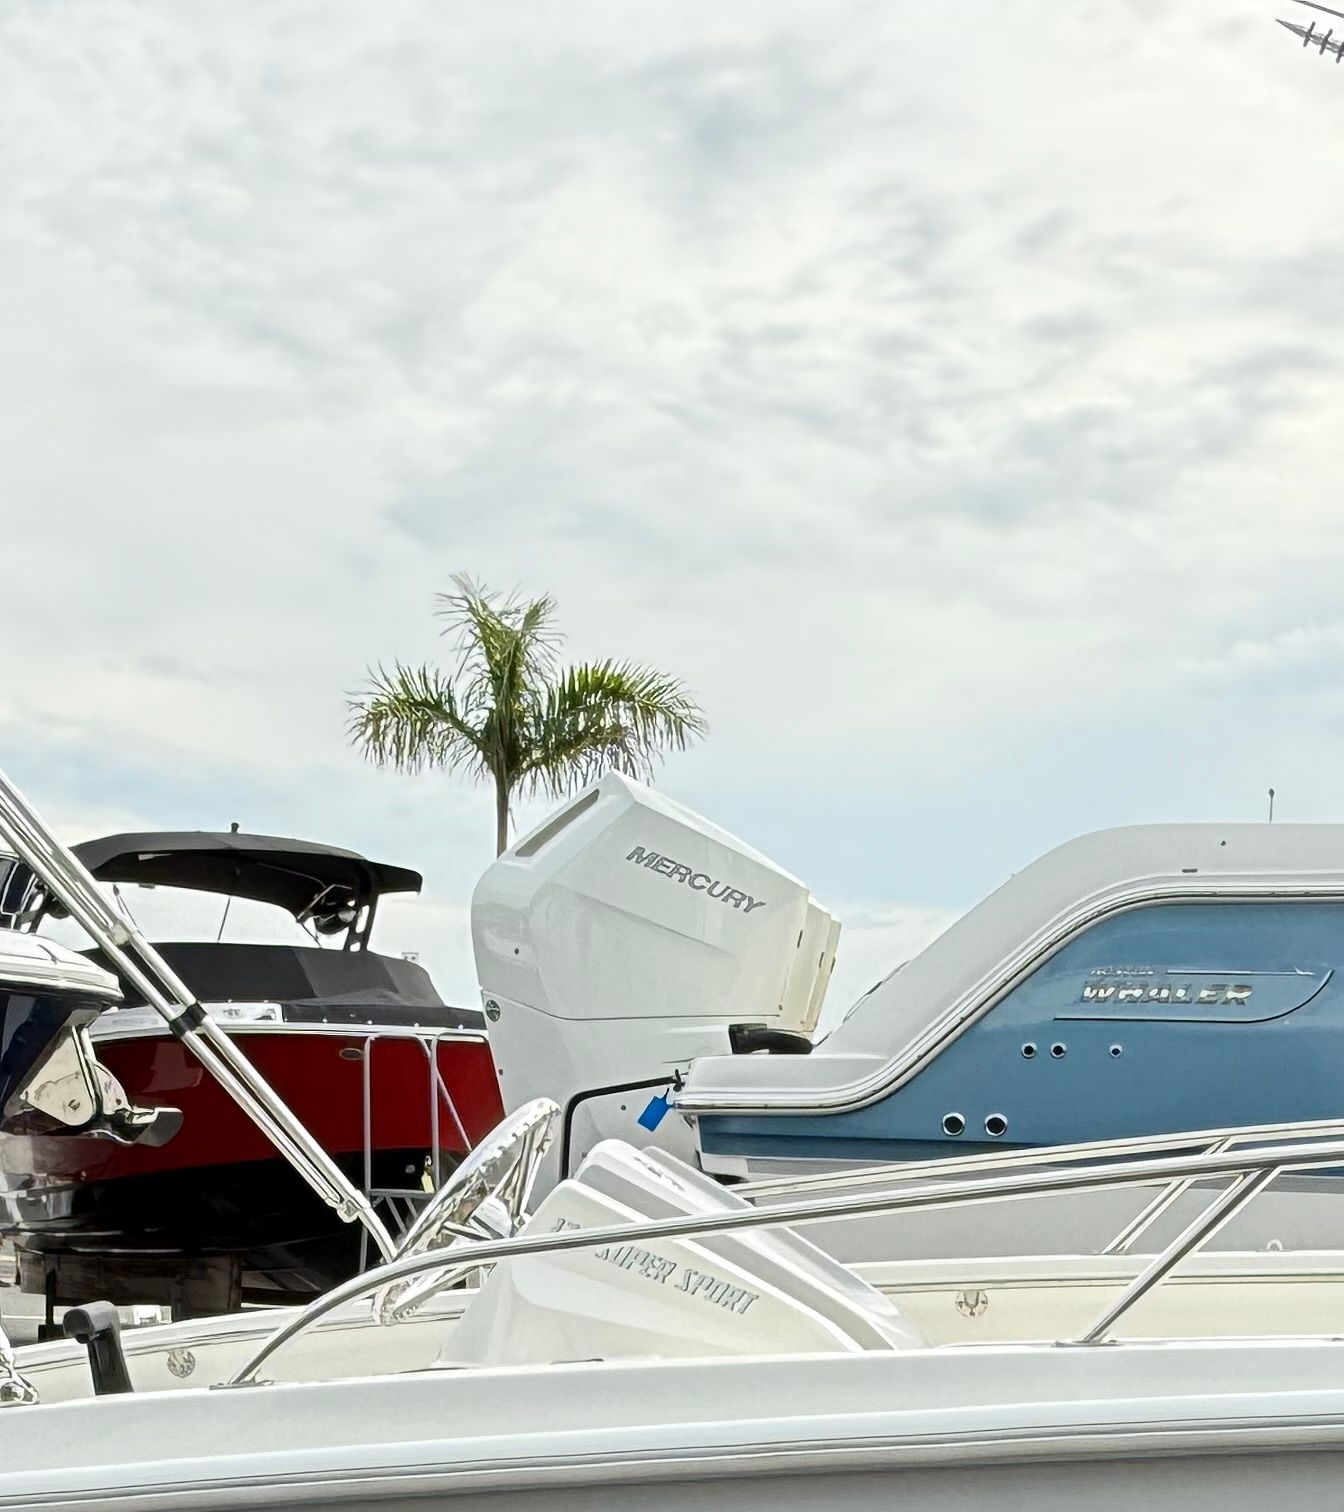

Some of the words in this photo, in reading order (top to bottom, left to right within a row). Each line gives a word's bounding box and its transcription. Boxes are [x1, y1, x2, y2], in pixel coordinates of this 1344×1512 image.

[625, 846, 767, 914] MERCURY
[1079, 981, 1254, 1006] WHALER
[674, 1268, 761, 1314] SPORT
